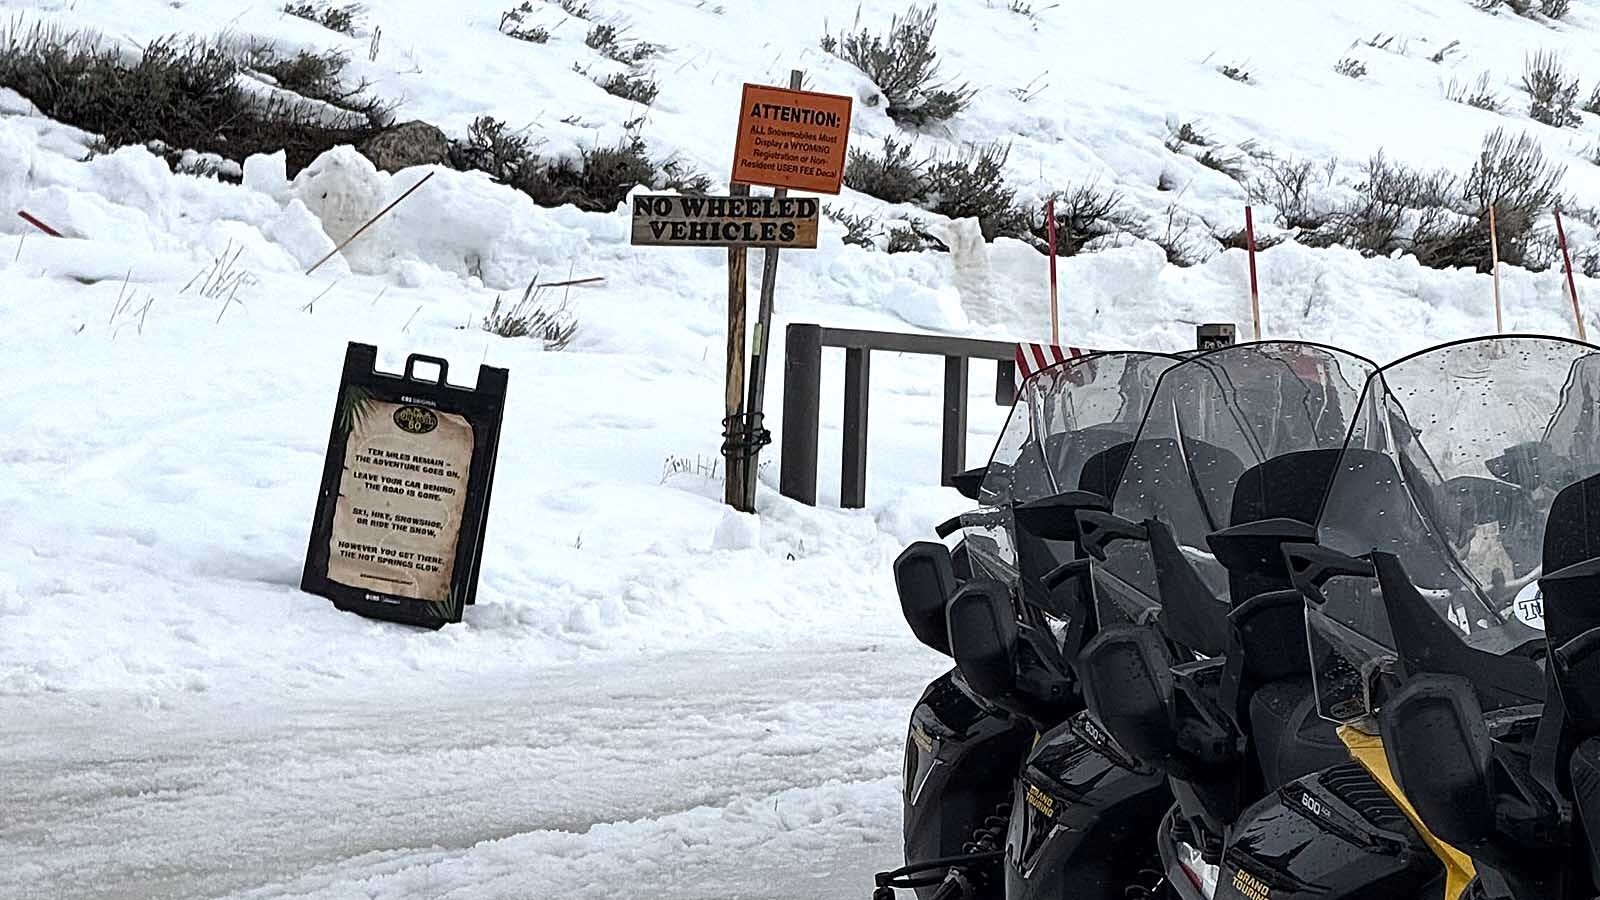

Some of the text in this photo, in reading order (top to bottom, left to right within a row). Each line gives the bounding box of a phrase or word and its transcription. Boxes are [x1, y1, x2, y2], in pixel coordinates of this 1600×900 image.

[751, 103, 841, 129] ATTENTION:
[750, 125, 838, 144] ALL Snowmobiles Must
[755, 137, 783, 149] Display
[790, 141, 830, 154] WYOMING
[753, 149, 829, 166] Registration or Non-
[740, 158, 838, 179] Resident USER FEE Decal
[634, 197, 817, 218] NO WHEELED
[650, 219, 796, 242] VEHICLES
[355, 454, 372, 464] THE
[372, 458, 420, 472] ADVENTURE
[422, 466, 444, 476] GOES
[368, 447, 385, 457] TEN
[412, 455, 444, 467] REMAIN
[353, 471, 378, 483] LEAVE
[381, 475, 403, 486] YOUR
[404, 480, 421, 489] CAR
[365, 481, 380, 491] THE
[382, 485, 405, 495] ROAD
[407, 489, 416, 497] IS
[356, 517, 368, 525] OR
[370, 519, 389, 529] RIDE
[391, 522, 408, 532] THE
[338, 540, 378, 554] HOWEVER
[380, 547, 397, 557] YOU
[398, 550, 414, 559] GET
[340, 550, 356, 559] THE
[358, 553, 375, 562] HOT
[377, 556, 414, 569] SPRINGS
[1085, 721, 1099, 741] 600
[1025, 791, 1055, 818] TOURING
[1029, 783, 1054, 808] GRAND
[1301, 792, 1321, 816] 600
[1232, 876, 1270, 900] TOURIN
[1236, 868, 1270, 897] GRAND
